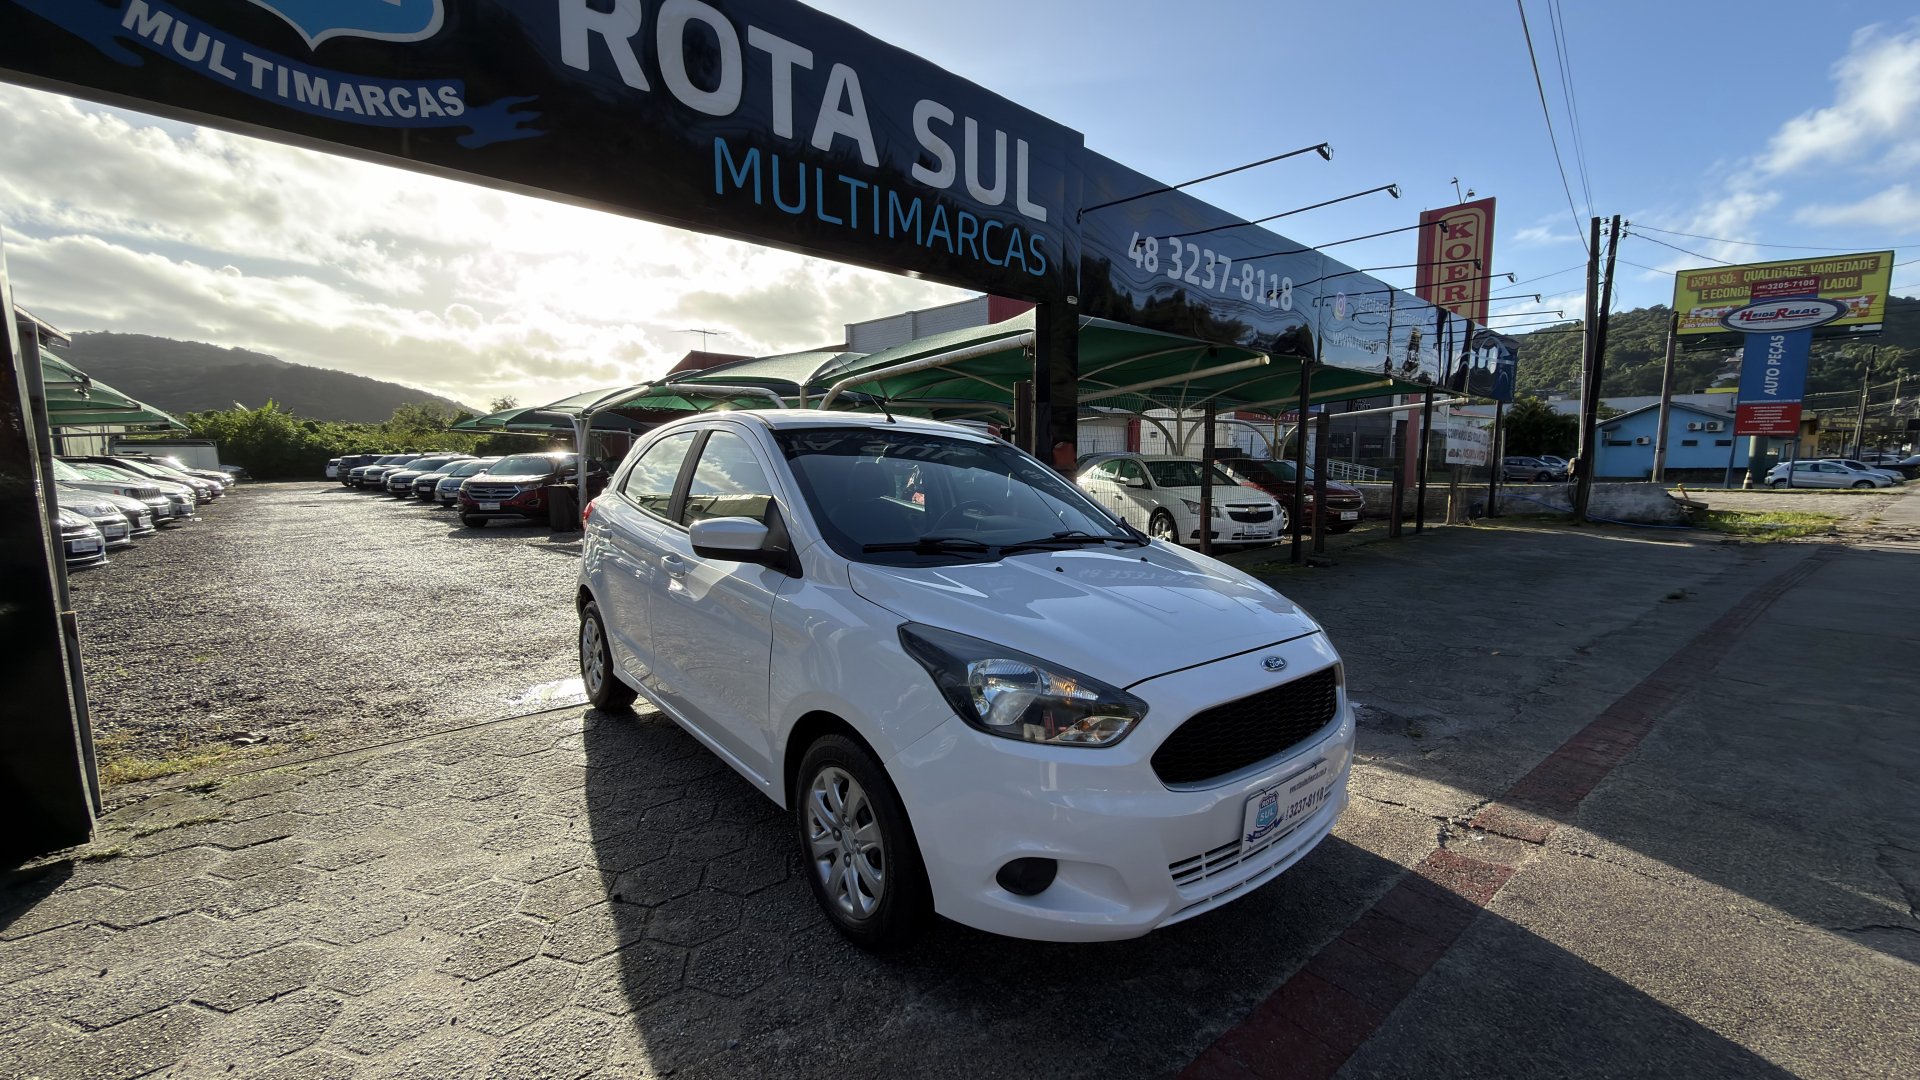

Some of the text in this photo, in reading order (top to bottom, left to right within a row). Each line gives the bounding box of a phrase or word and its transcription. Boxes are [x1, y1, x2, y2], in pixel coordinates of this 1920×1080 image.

[121, 0, 465, 118] MULTIMARCAS
[559, 0, 1047, 222] ROTA SUL
[714, 137, 1047, 277] MULTIMARCAS
[1128, 231, 1293, 311] 48 3237-8118
[1810, 259, 1876, 274] VARIEDADE
[1823, 276, 1858, 290] LADO!
[1763, 335, 1788, 396] AUTO PEÇAS
[1260, 807, 1275, 822] SUL
[1288, 787, 1325, 819] 3237-8118
